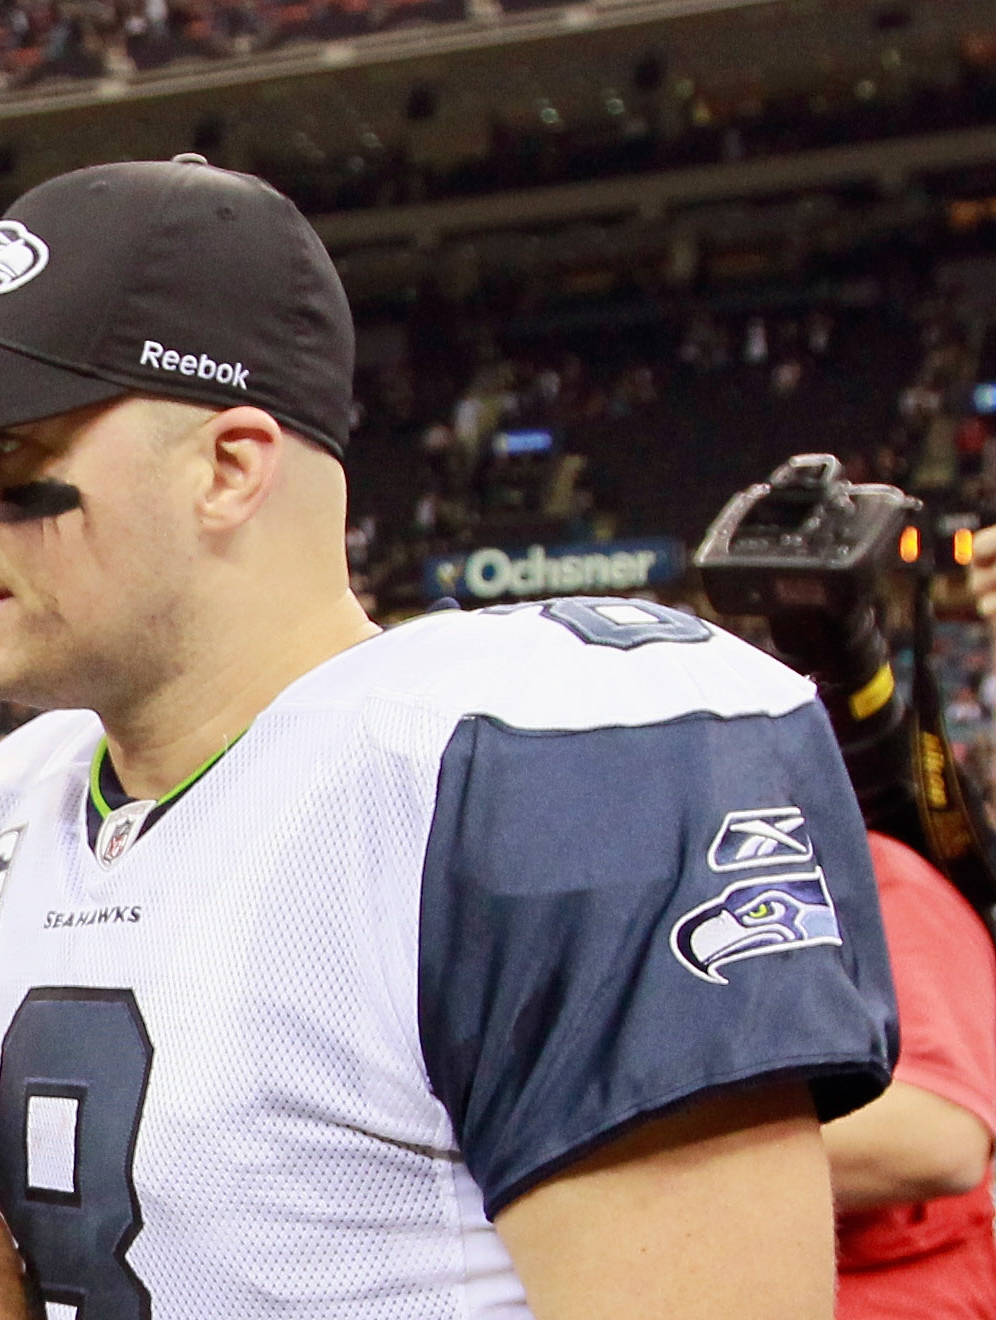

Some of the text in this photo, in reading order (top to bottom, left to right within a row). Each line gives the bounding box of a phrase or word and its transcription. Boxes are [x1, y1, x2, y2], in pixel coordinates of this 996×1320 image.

[139, 339, 251, 391] Reebok
[464, 544, 655, 599] Ochsner
[42, 905, 142, 930] SEAHAWKS
